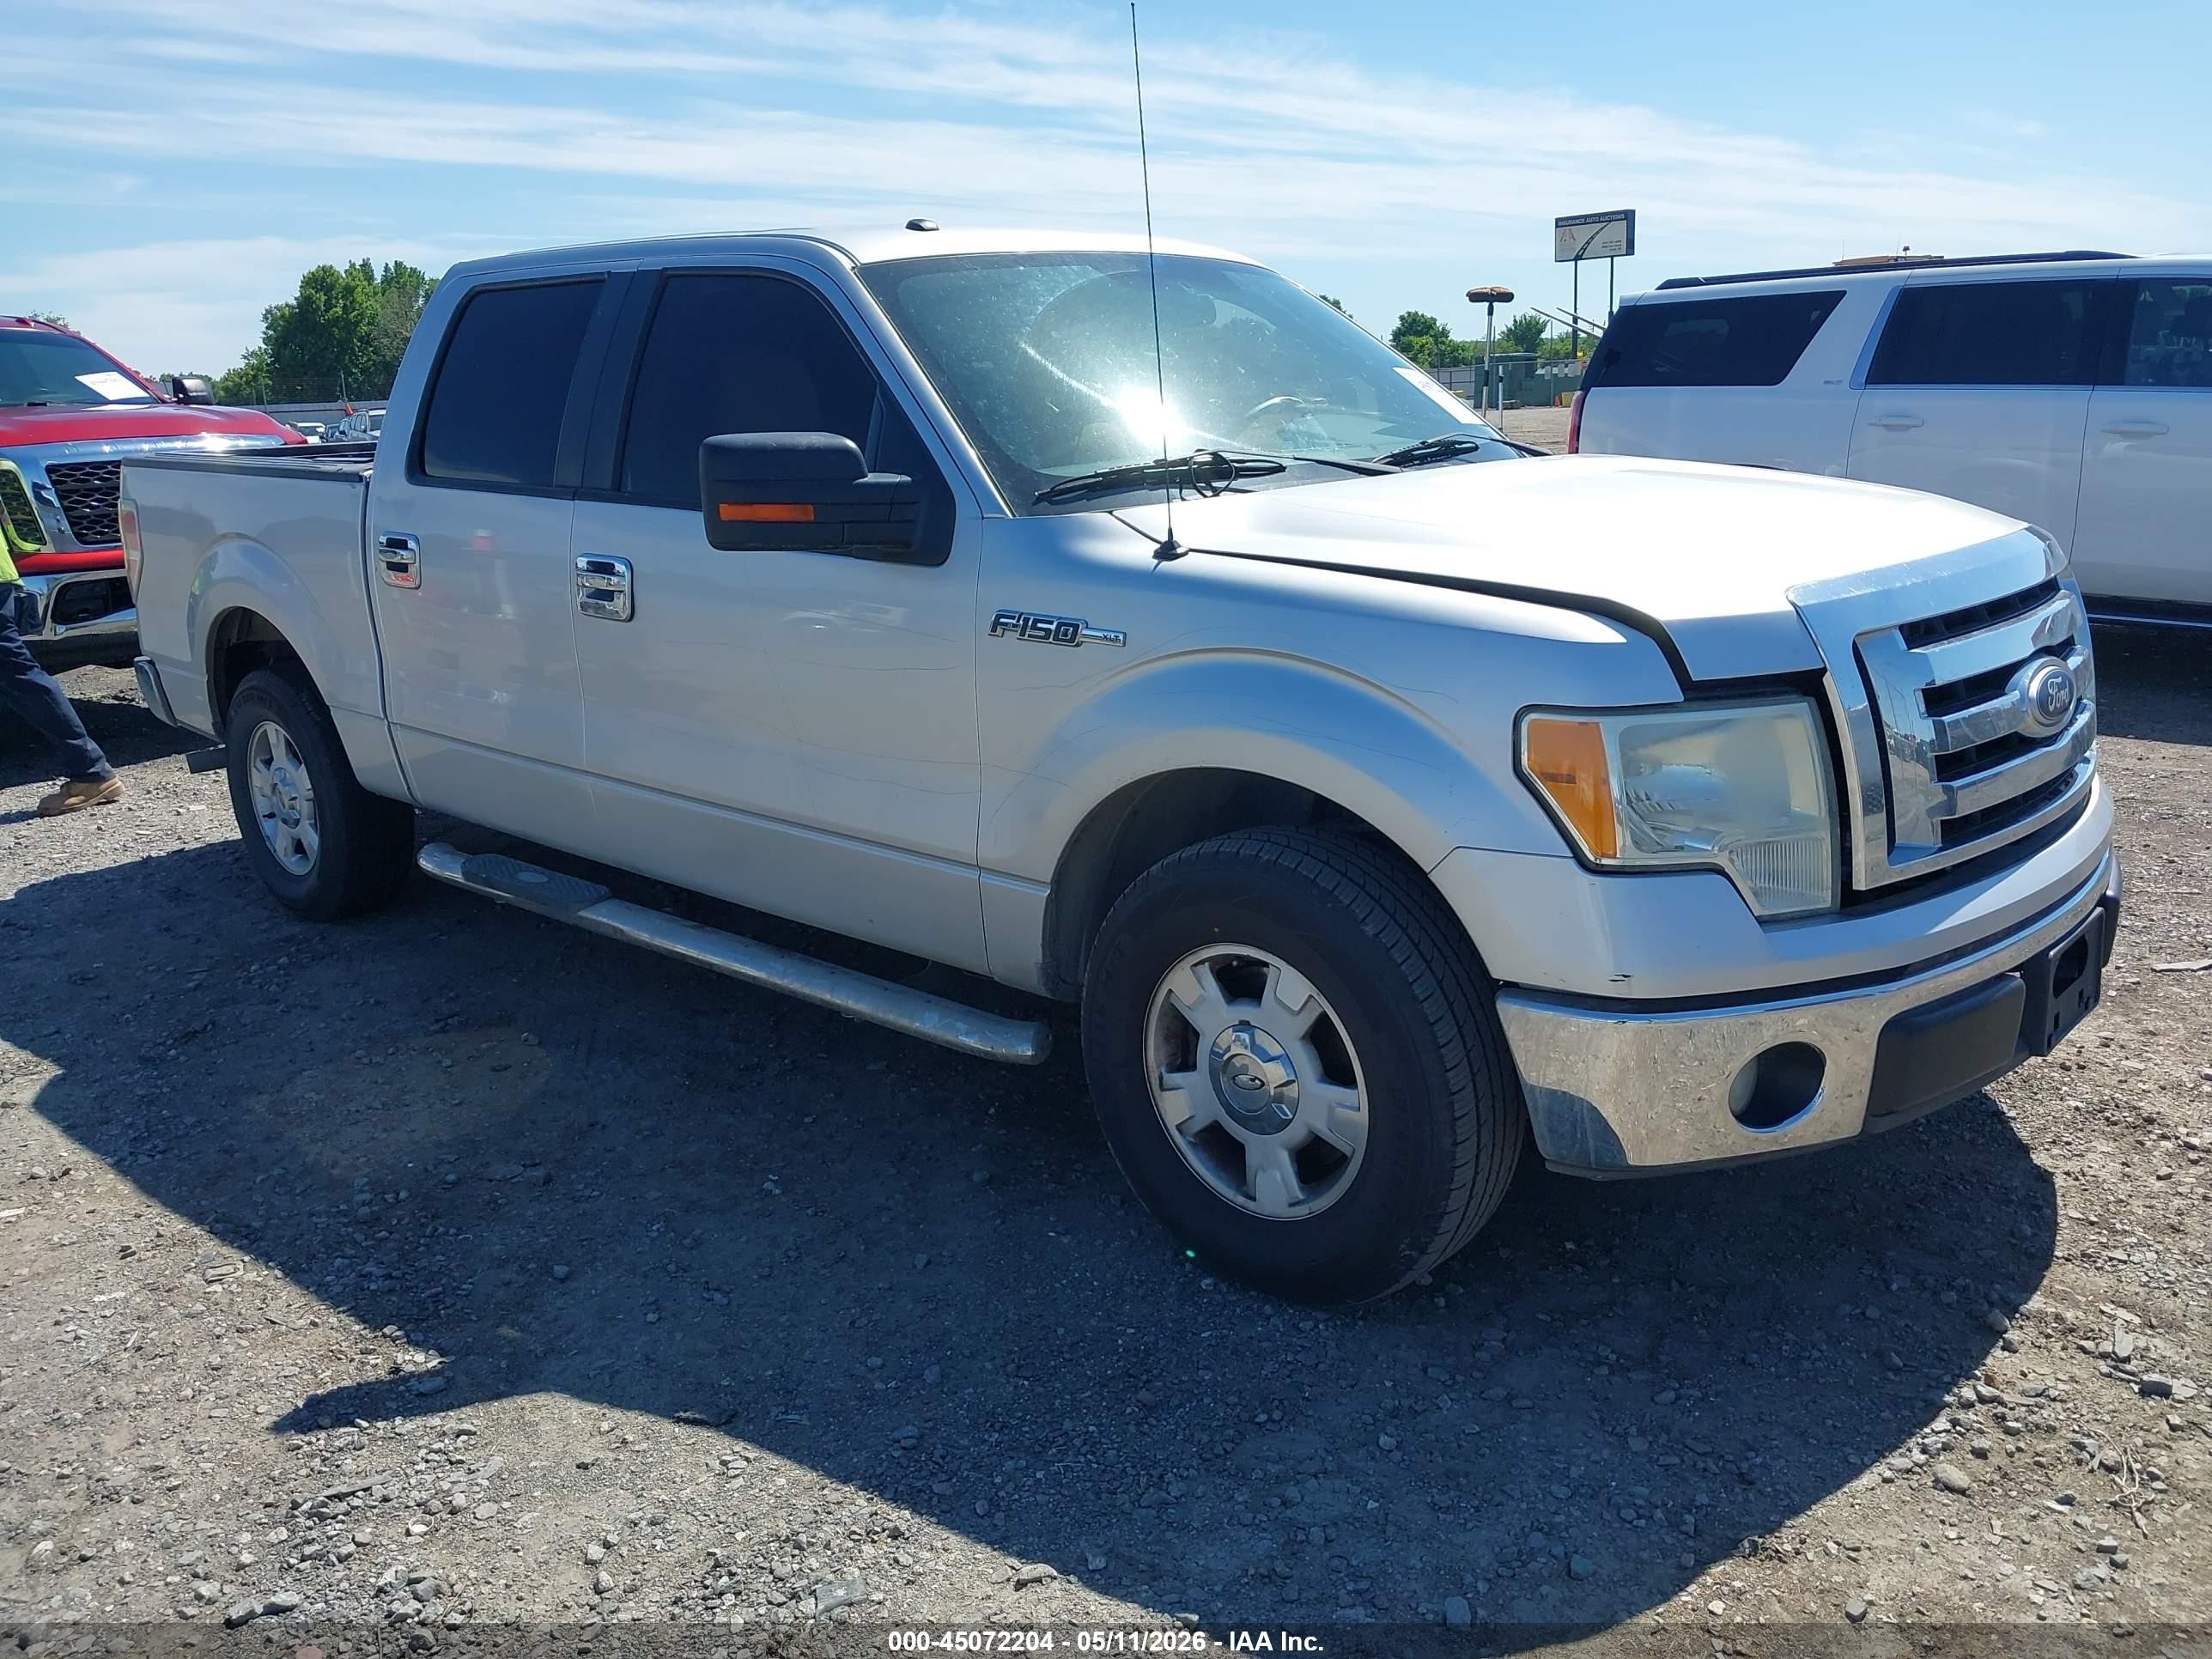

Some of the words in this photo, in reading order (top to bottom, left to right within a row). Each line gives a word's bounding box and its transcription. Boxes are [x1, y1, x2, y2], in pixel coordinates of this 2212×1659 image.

[1600, 213, 1625, 222] AUCTIONS
[1102, 633, 1121, 643] XLT
[2047, 676, 2070, 712] Ford
